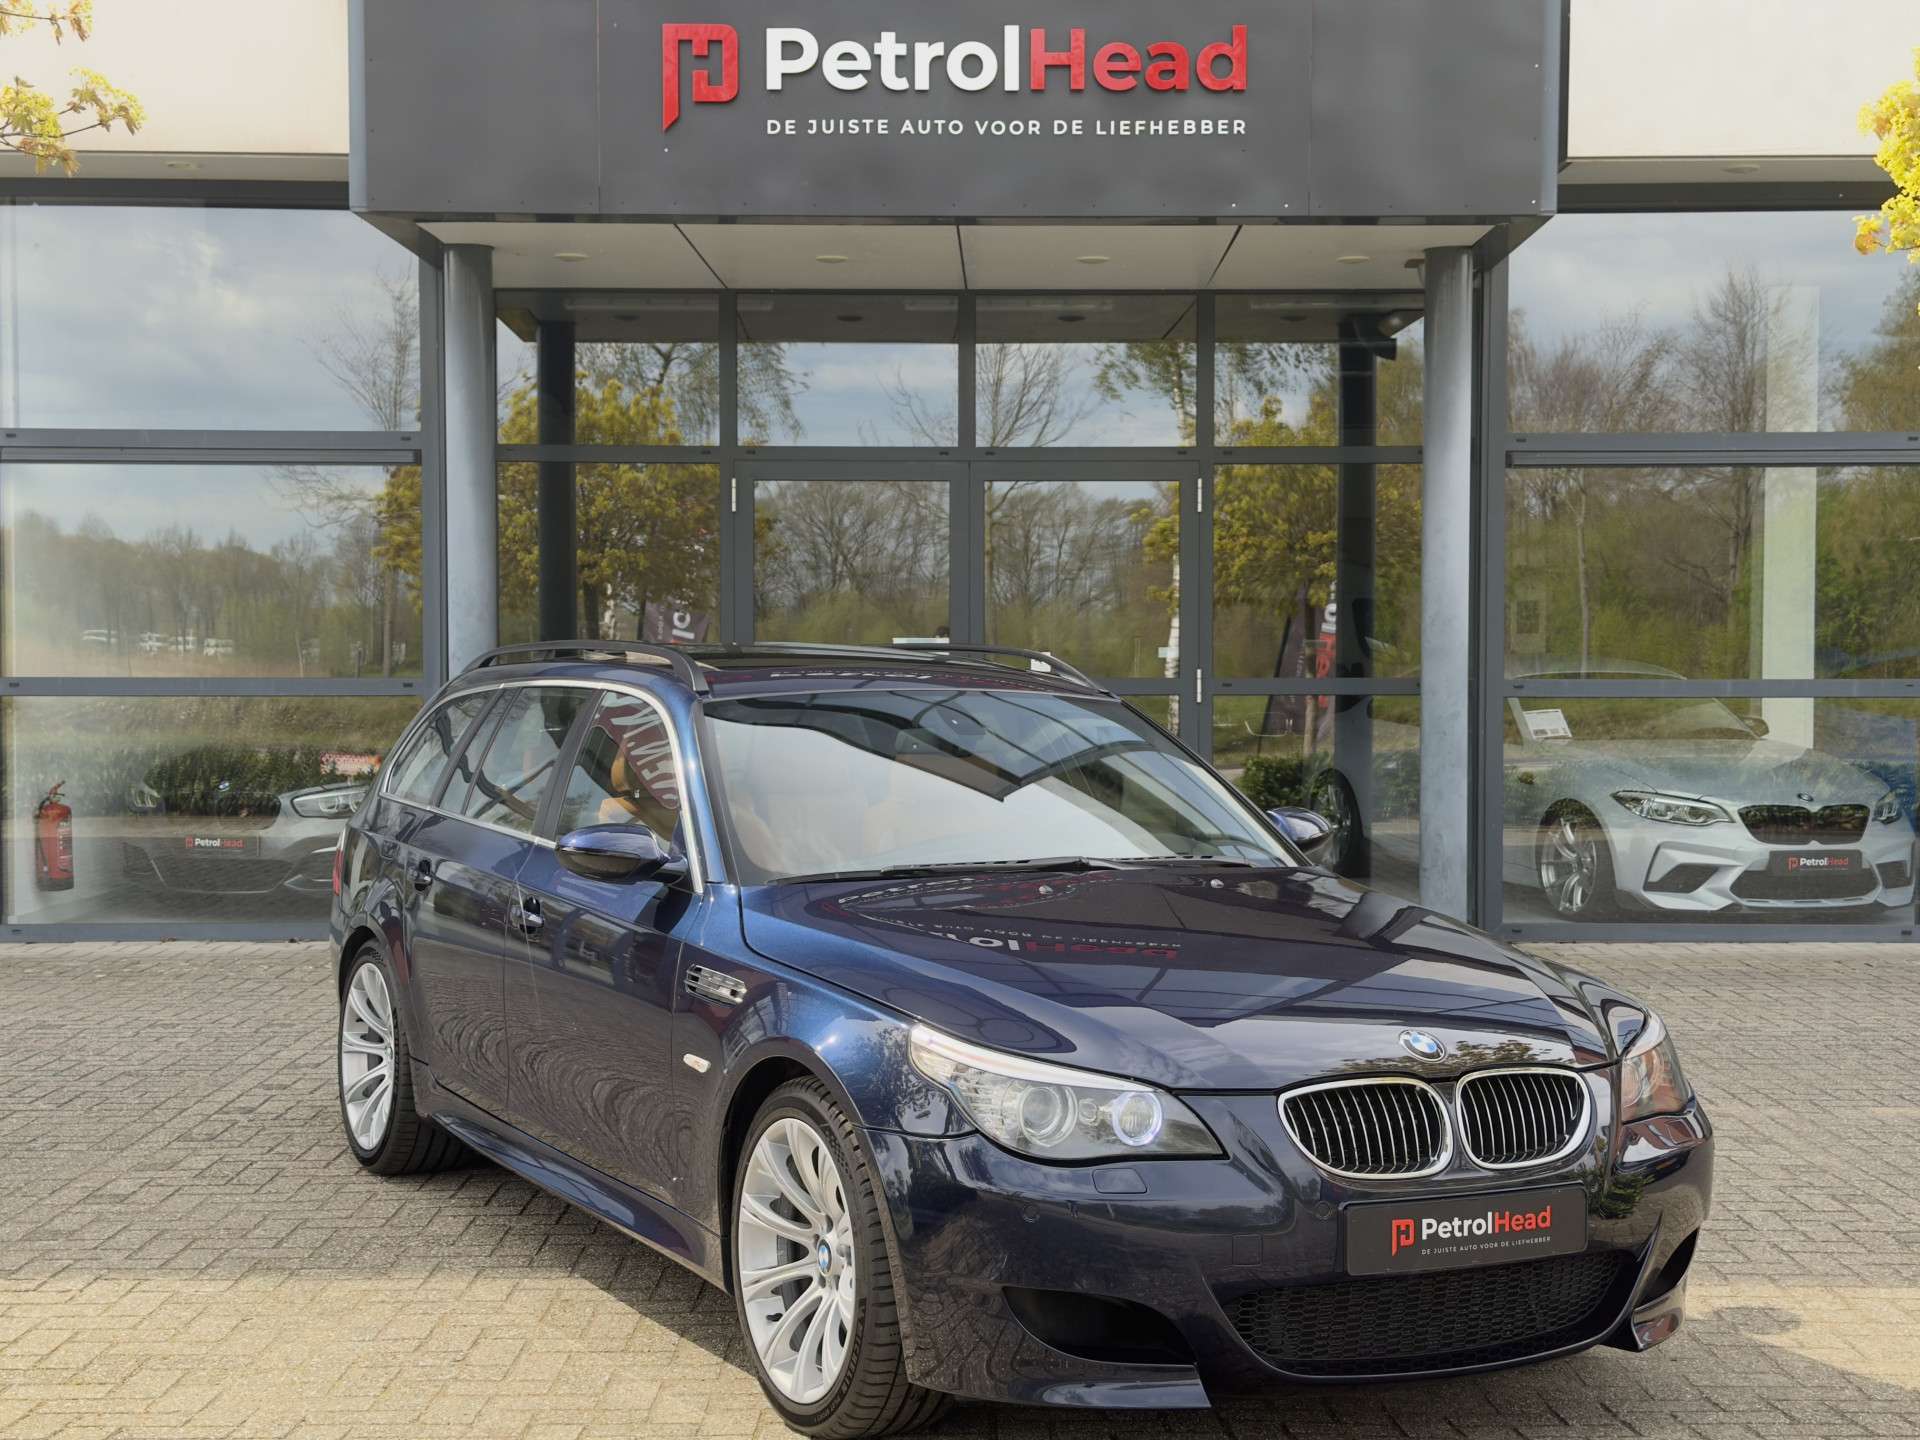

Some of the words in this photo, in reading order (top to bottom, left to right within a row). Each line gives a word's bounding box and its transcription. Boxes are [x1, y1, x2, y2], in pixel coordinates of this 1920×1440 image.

[765, 24, 1248, 92] PetrolHead
[766, 119, 797, 135] DE
[807, 119, 889, 135] JUISTE
[900, 119, 964, 135] AUTO
[974, 120, 1041, 135] VOOR
[1053, 119, 1084, 135] DE
[1096, 119, 1246, 135] LIEFHEBBER
[1421, 1205, 1553, 1241] PetrolHead
[1433, 1246, 1457, 1254] JUISTE
